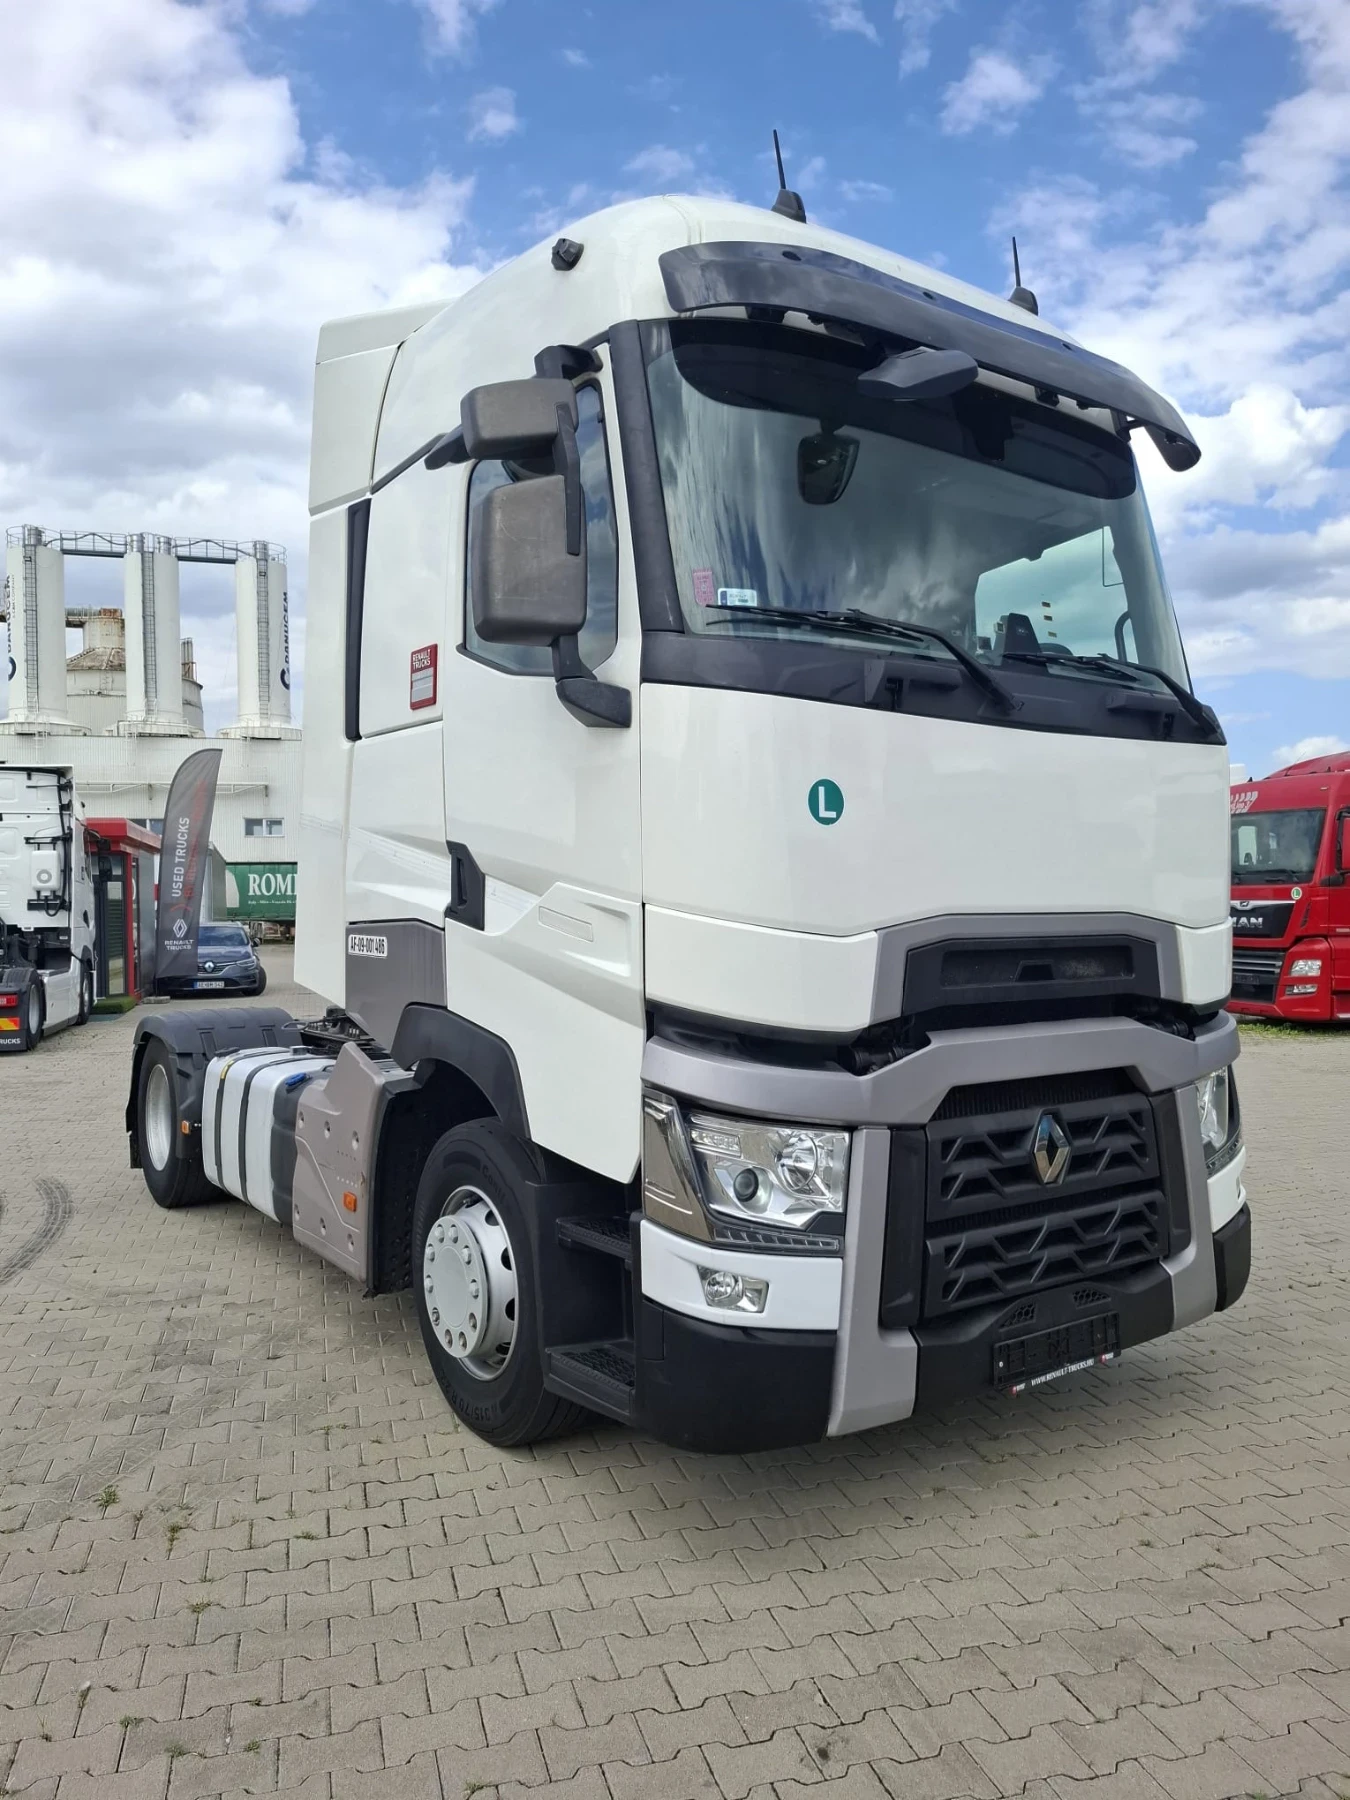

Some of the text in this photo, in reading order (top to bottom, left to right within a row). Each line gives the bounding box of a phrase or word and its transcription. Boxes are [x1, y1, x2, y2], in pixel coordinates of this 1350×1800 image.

[412, 649, 431, 662] RENAULT
[412, 658, 431, 670] TRUCKS
[818, 786, 837, 818] L
[172, 817, 189, 897] USED TRUCKS
